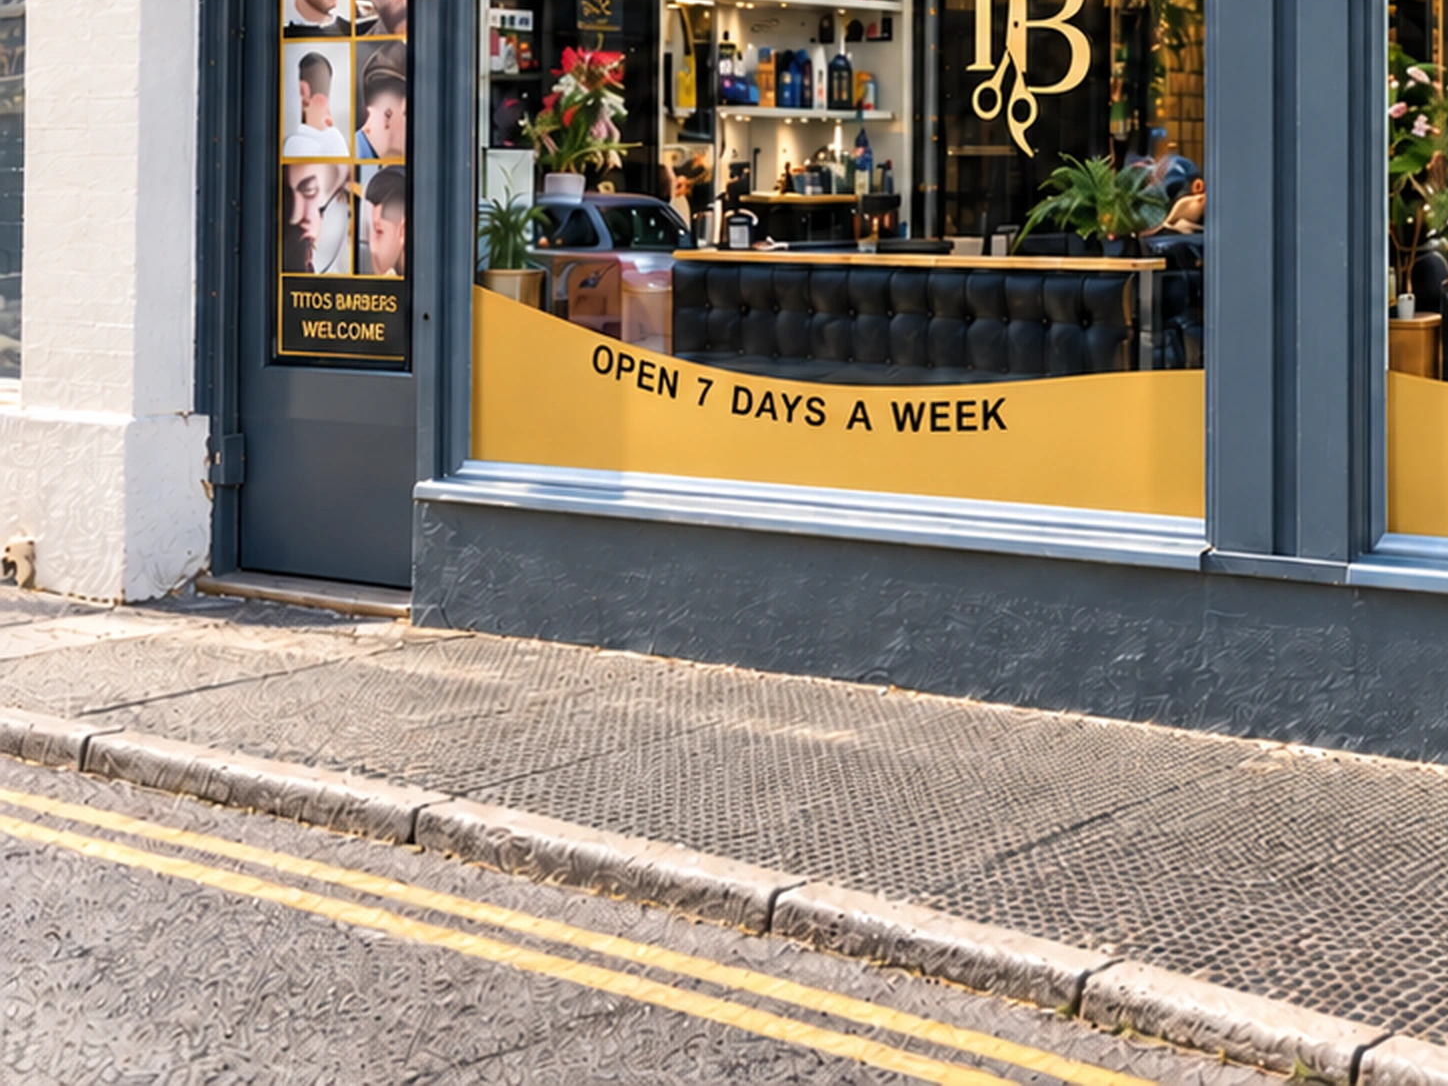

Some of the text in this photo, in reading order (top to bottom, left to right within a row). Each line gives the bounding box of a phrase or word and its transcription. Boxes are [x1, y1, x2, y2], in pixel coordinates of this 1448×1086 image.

[290, 291, 398, 313] TITOS BARBERS
[301, 320, 385, 341] WELCOME
[591, 343, 1008, 433] OPEN 7 DAYS A WEEK
